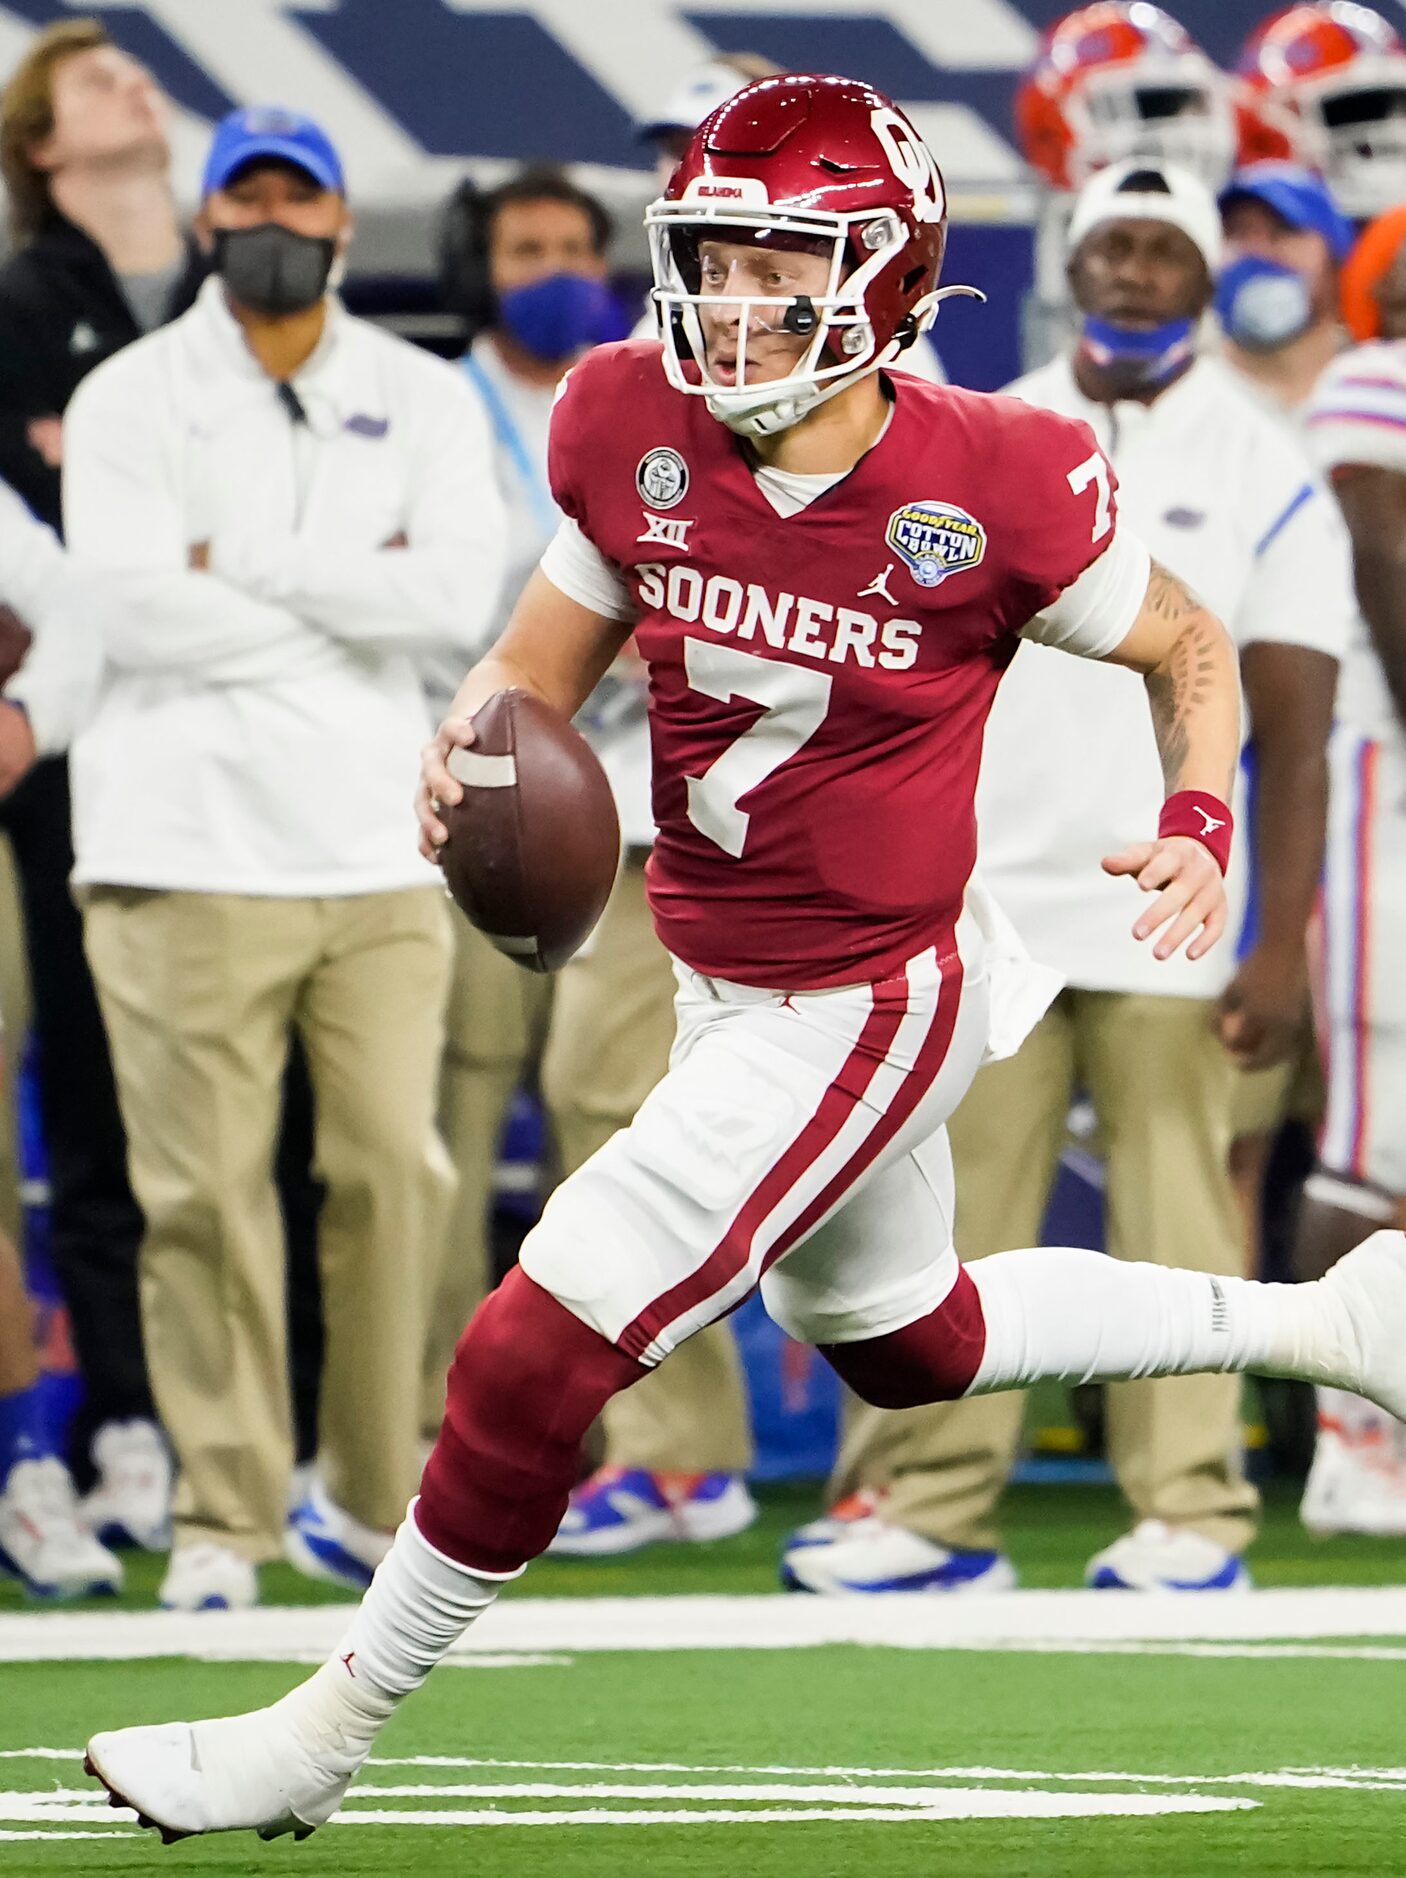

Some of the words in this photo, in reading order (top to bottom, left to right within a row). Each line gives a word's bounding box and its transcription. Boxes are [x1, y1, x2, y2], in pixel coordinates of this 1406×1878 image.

[870, 108, 947, 224] OU
[895, 519, 977, 560] COTTON
[902, 510, 978, 534] GOODYEAR
[1066, 453, 1119, 544] 7
[906, 537, 960, 563] BOWL
[634, 562, 923, 671] SOONERS
[683, 636, 834, 860] 7
